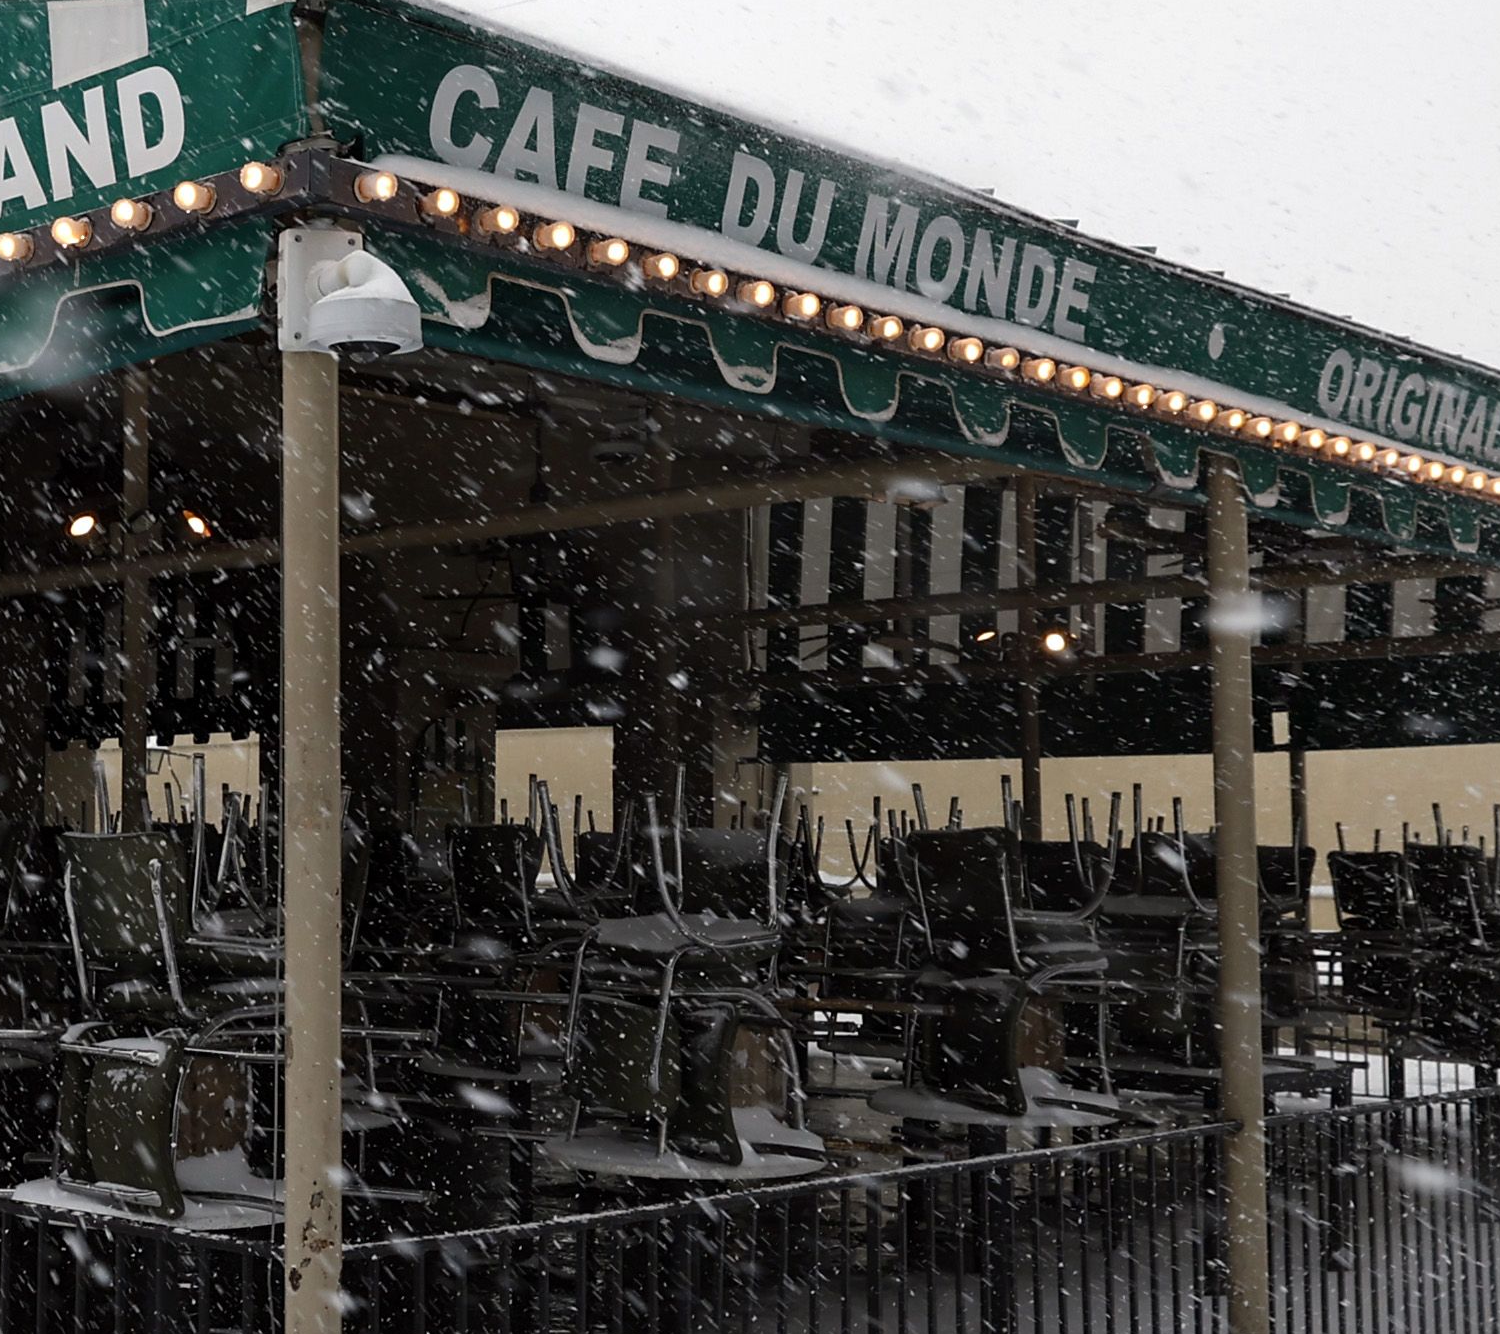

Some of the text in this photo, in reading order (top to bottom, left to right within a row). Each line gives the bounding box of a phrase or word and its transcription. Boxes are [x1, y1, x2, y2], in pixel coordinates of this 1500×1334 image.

[429, 65, 681, 219] CAFE
[722, 153, 836, 264] DU
[854, 193, 1097, 341] MONDE
